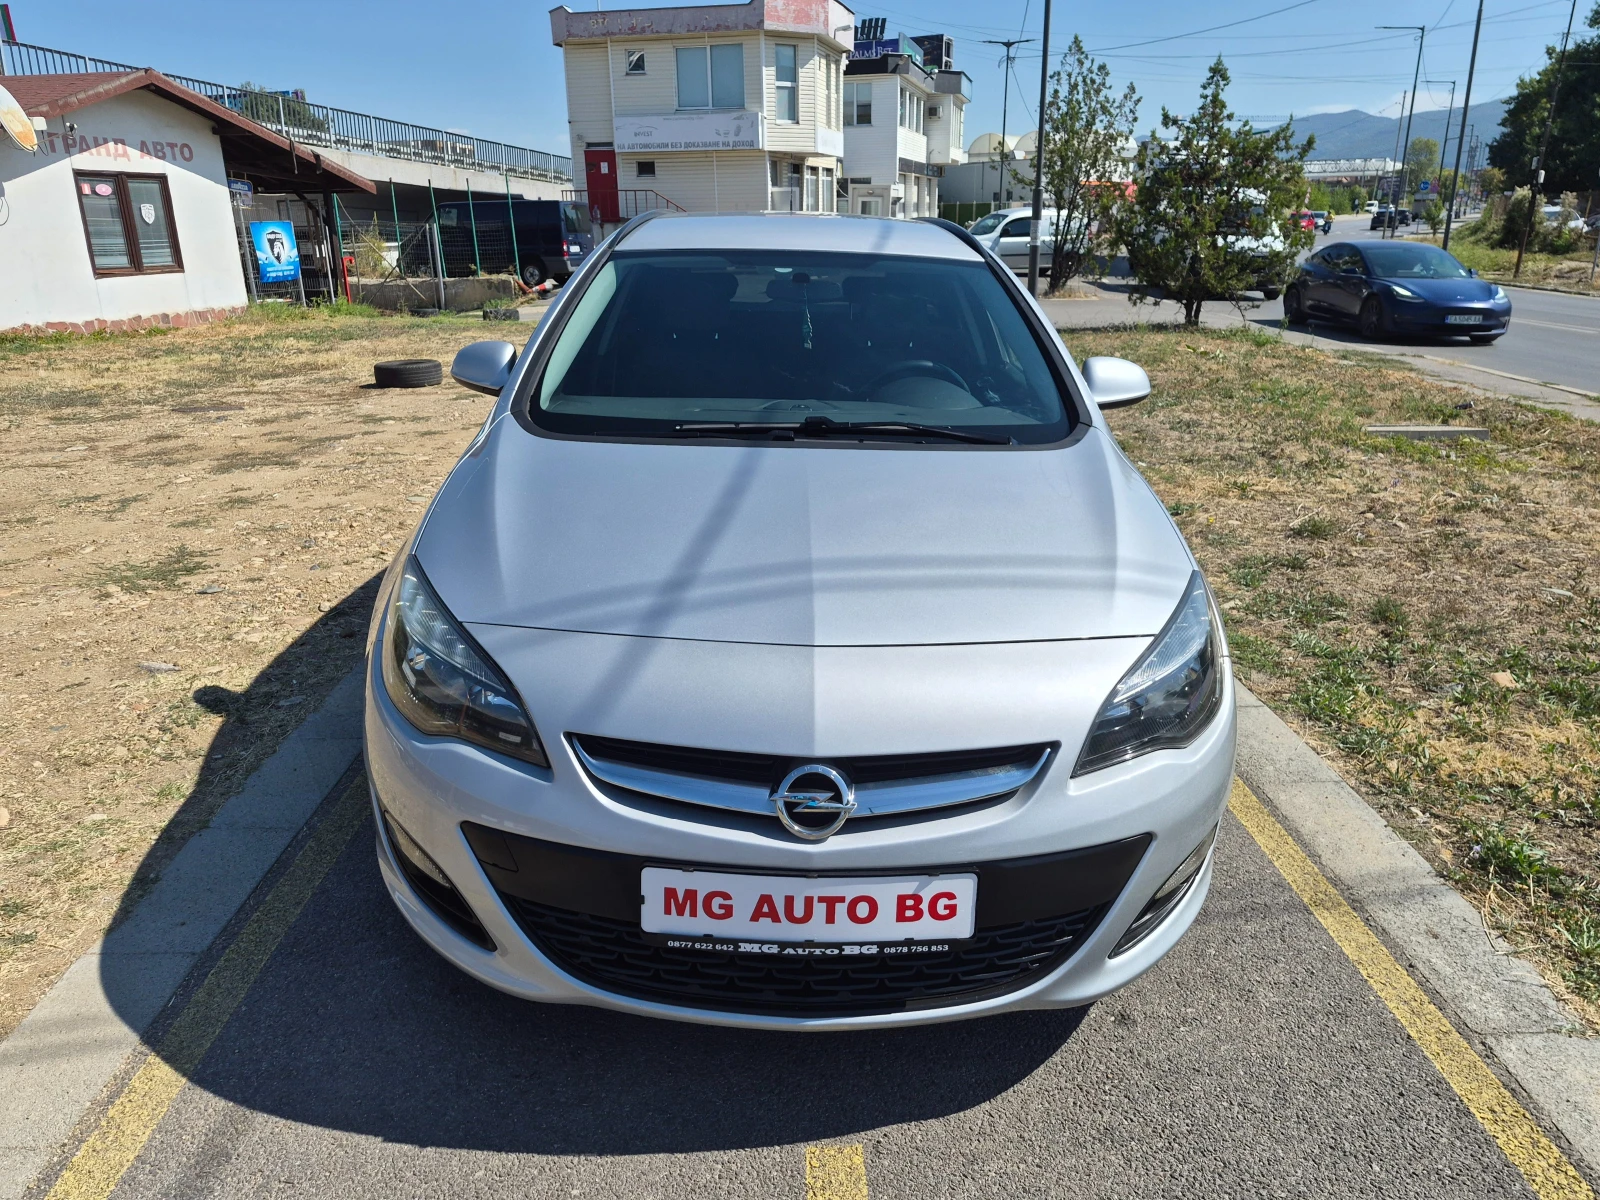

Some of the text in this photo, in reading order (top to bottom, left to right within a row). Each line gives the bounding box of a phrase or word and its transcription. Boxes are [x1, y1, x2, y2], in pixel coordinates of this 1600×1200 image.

[47, 131, 194, 163] ГРАНД АВТО
[627, 142, 669, 150] АВТОМОБИЛИ
[670, 141, 683, 149] БЕЗ
[683, 140, 721, 149] ДОКАЗВАНЕ
[722, 140, 731, 148] НА
[731, 139, 755, 148] ДОХОД
[663, 886, 958, 925] MG AUTO BG
[667, 940, 949, 955] 0877 622 642 MG AUTO BG 0878 756 853
